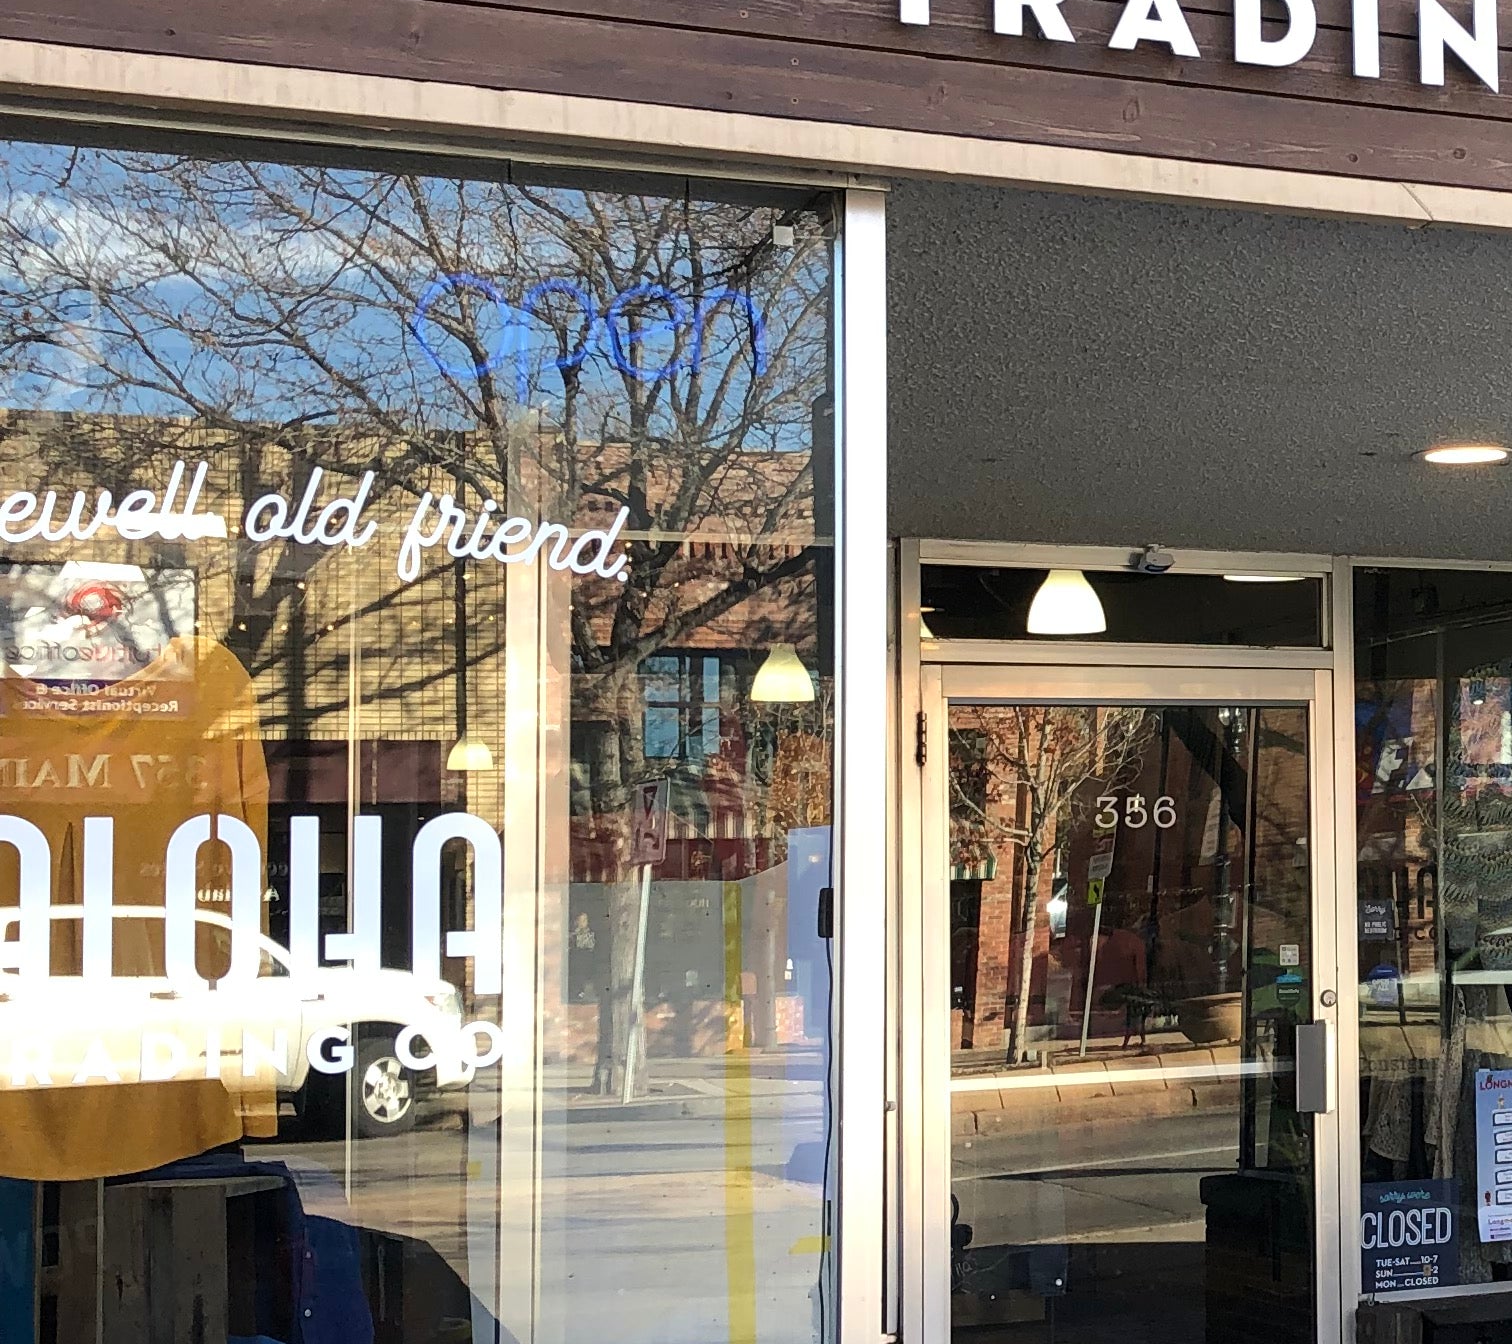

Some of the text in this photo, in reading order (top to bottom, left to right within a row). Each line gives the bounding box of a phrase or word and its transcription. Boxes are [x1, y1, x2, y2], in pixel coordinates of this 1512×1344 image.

[413, 272, 767, 404] open
[244, 466, 376, 547] old
[398, 491, 632, 583] friend.
[1095, 795, 1177, 829] 356
[1360, 1207, 1452, 1250] CLOSED
[1375, 1269, 1394, 1278] SUN
[1375, 1276, 1439, 1289] MON CLOSED
